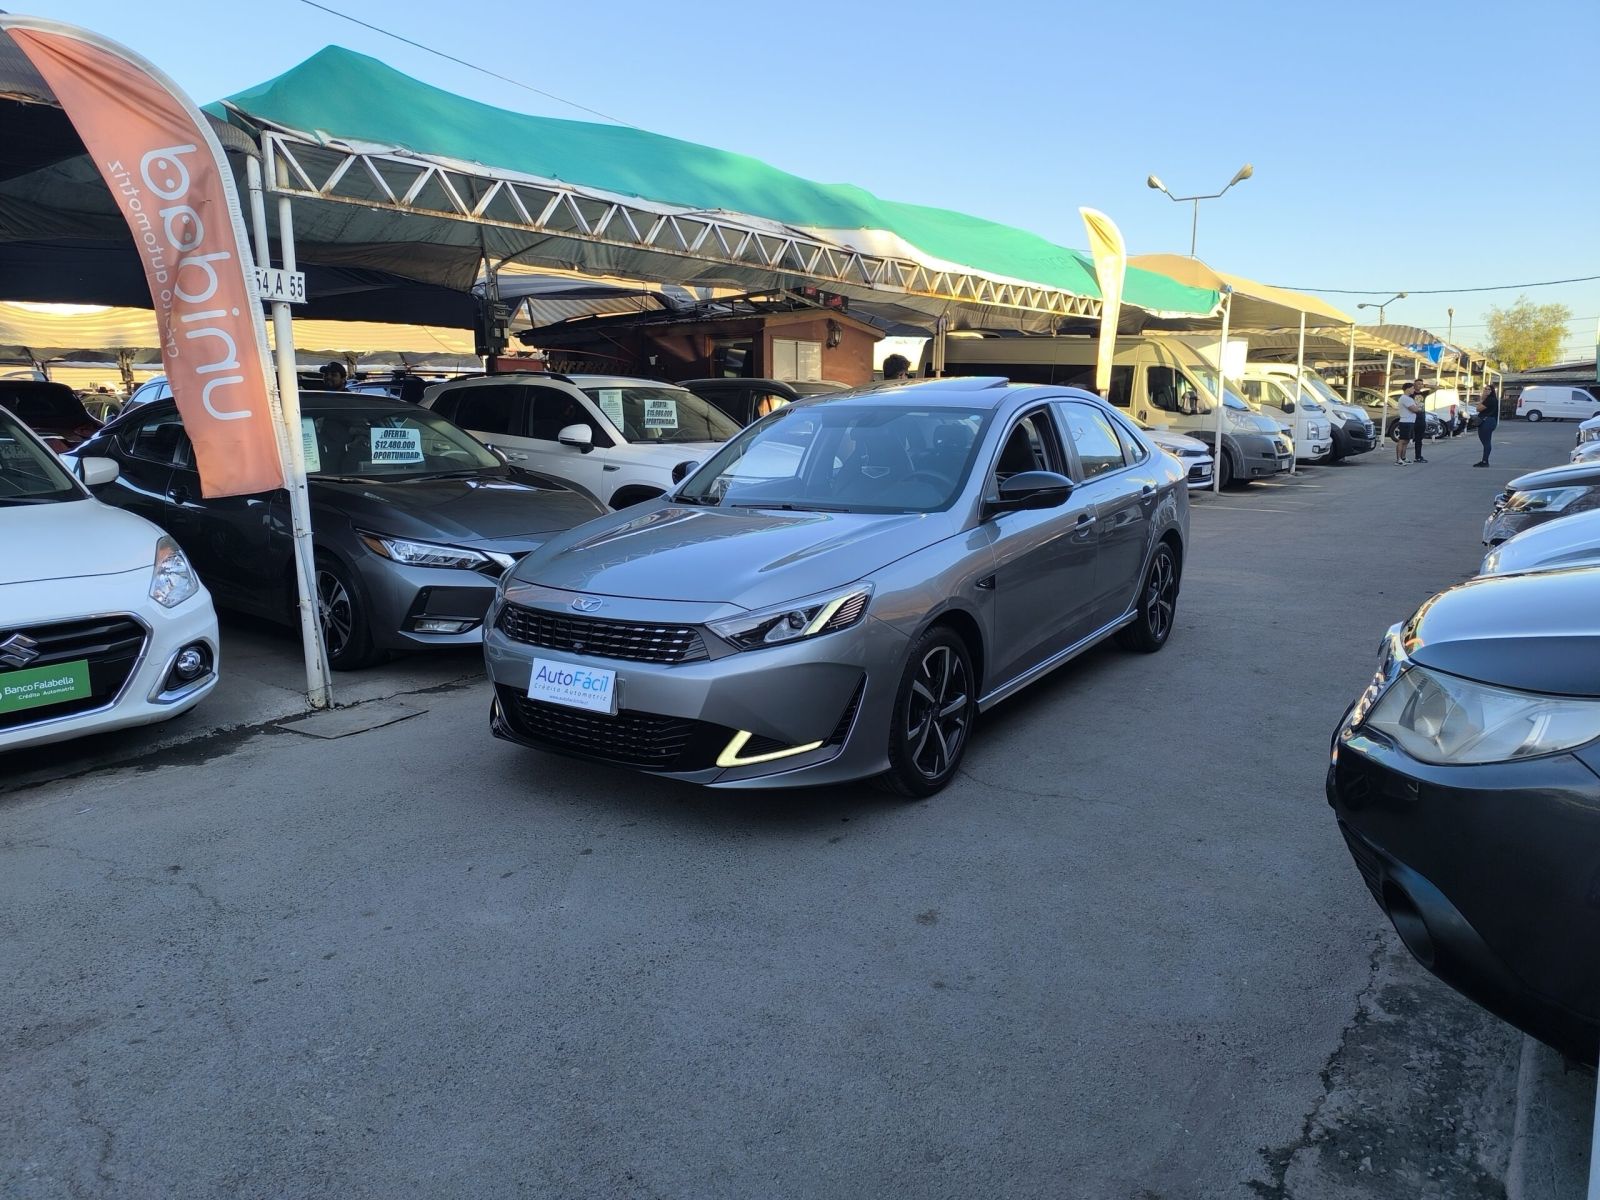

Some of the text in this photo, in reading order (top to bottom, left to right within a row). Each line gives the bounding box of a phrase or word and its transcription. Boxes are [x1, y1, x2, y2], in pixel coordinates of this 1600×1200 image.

[275, 272, 284, 295] A
[290, 275, 303, 298] 55
[4, 676, 74, 695] Banco Falabella
[535, 665, 609, 693] AutoFácil
